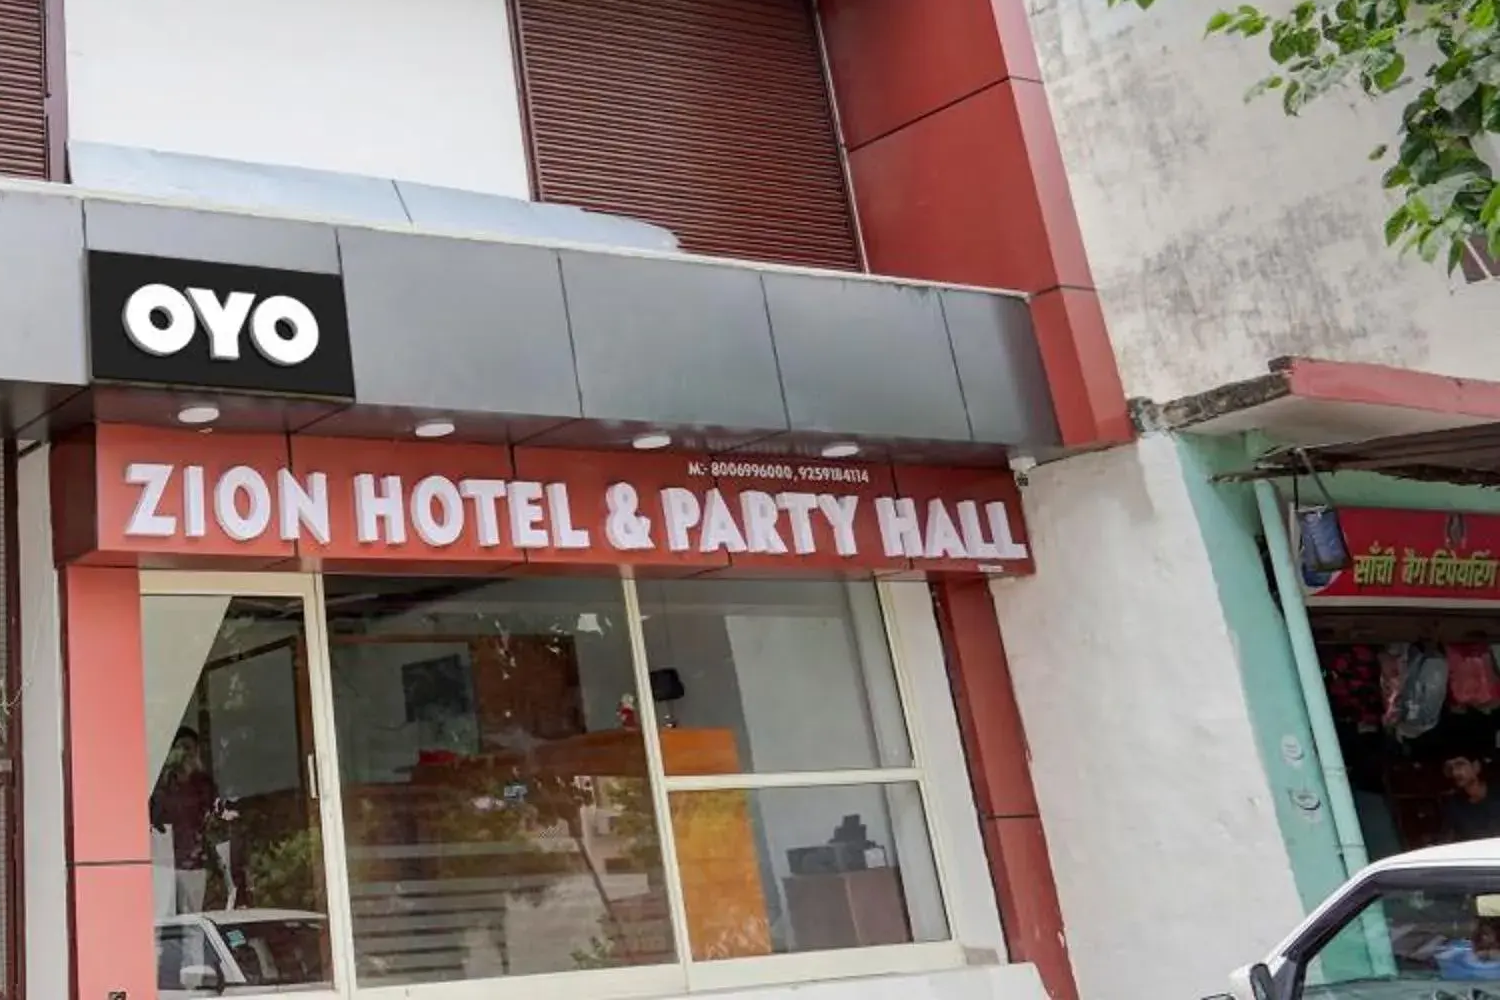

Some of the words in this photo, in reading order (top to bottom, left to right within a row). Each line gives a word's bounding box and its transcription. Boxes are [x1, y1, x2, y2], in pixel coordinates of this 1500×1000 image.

[122, 283, 320, 365] OYO
[124, 463, 330, 545] ZION
[353, 473, 590, 548] HOTEL
[605, 482, 655, 550] &
[660, 487, 859, 556] PARTY
[875, 496, 1028, 559] HALL
